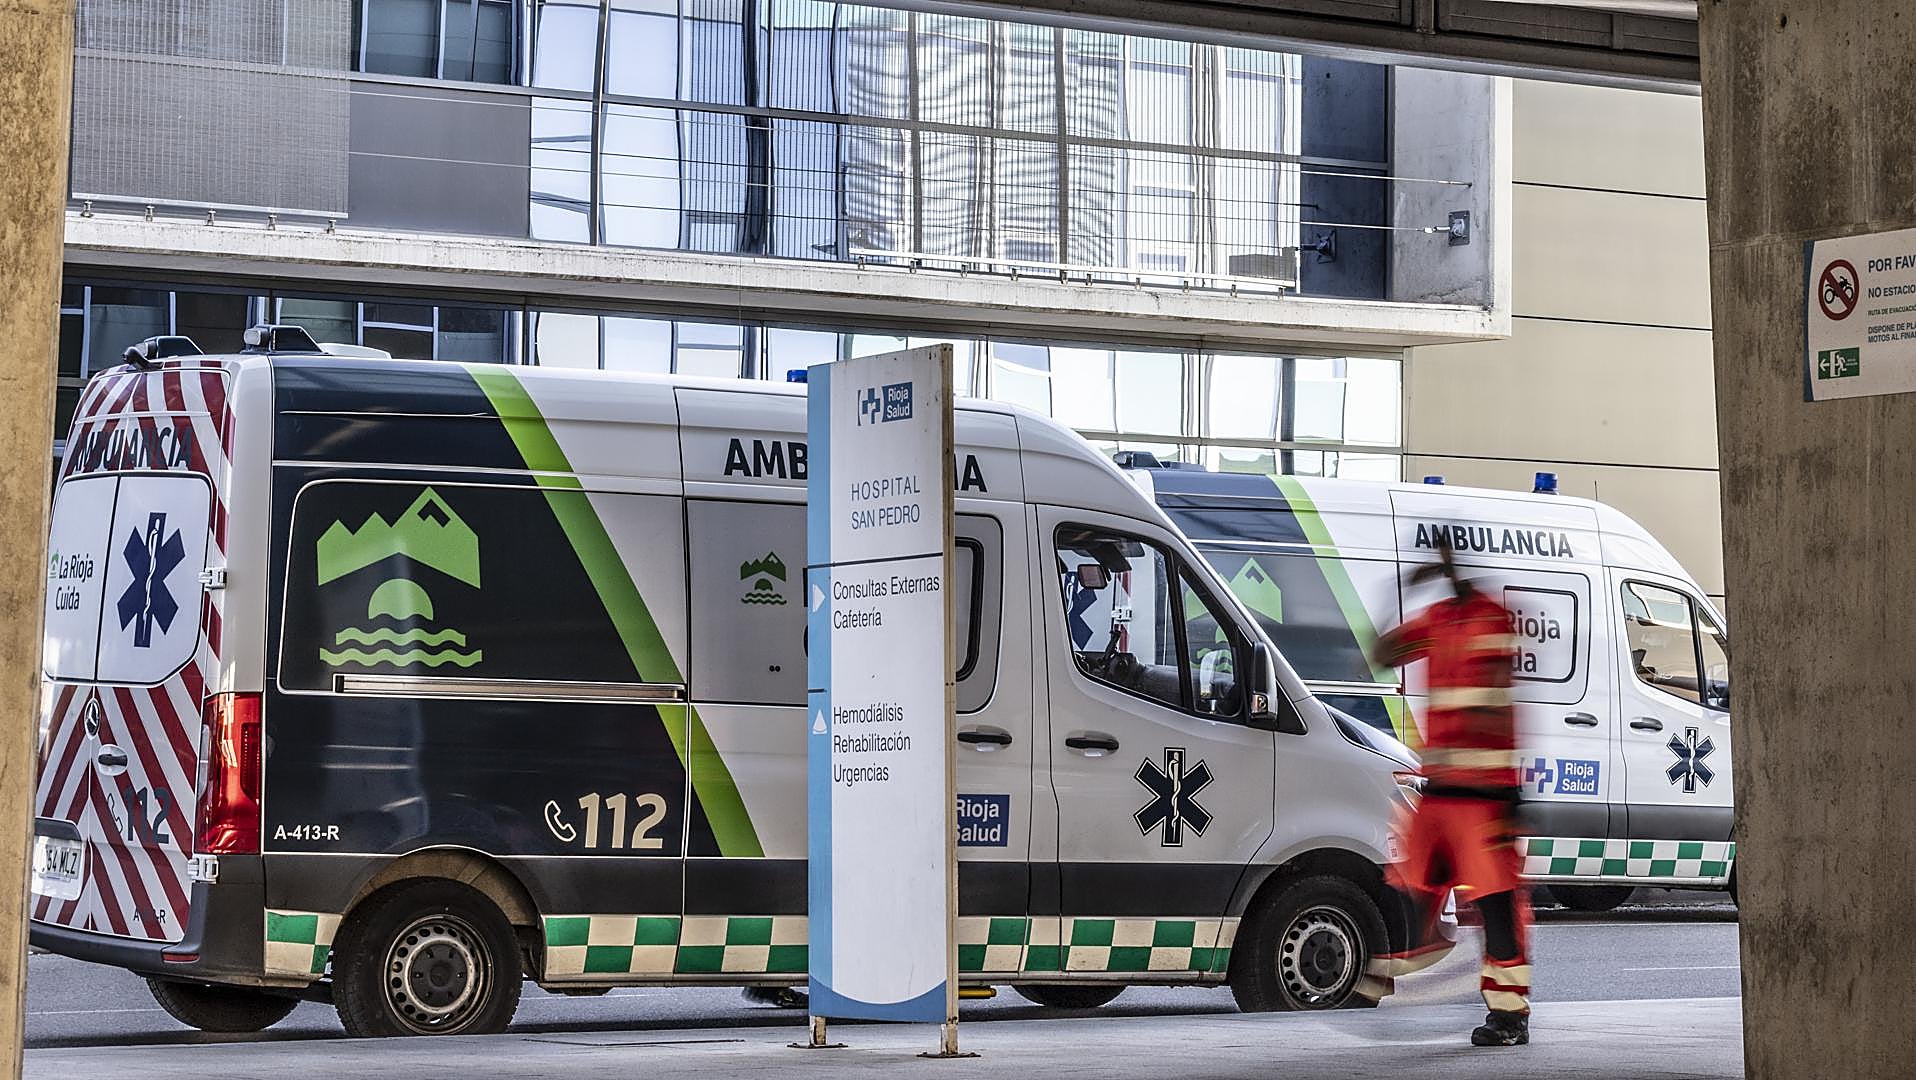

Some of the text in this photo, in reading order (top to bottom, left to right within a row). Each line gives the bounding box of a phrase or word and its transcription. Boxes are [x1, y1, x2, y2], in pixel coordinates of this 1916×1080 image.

[1868, 255, 1916, 273] POR FAV
[1868, 284, 1916, 299] NO ESTACIO
[1896, 322, 1905, 331] DE
[888, 387, 909, 402] Rioja
[887, 402, 910, 418] Salud
[852, 476, 920, 500] HOSPITAL
[852, 503, 920, 530] SAN PEDRO
[1414, 523, 1574, 558] AMBULANCIA
[59, 553, 94, 583] La Rioja
[56, 585, 80, 611] Cuida
[833, 574, 940, 601] Consultas Externas
[833, 606, 882, 629] Cafetería
[833, 703, 903, 725] Hemodiálisis
[833, 732, 911, 754] Rehabilitación
[833, 763, 889, 787] Urgencias
[1565, 762, 1594, 779] Rioja
[1562, 778, 1595, 792] Salud
[125, 786, 172, 845] 112
[578, 792, 668, 849] 112
[956, 798, 999, 823] Rioja
[273, 825, 340, 841] A-413-R
